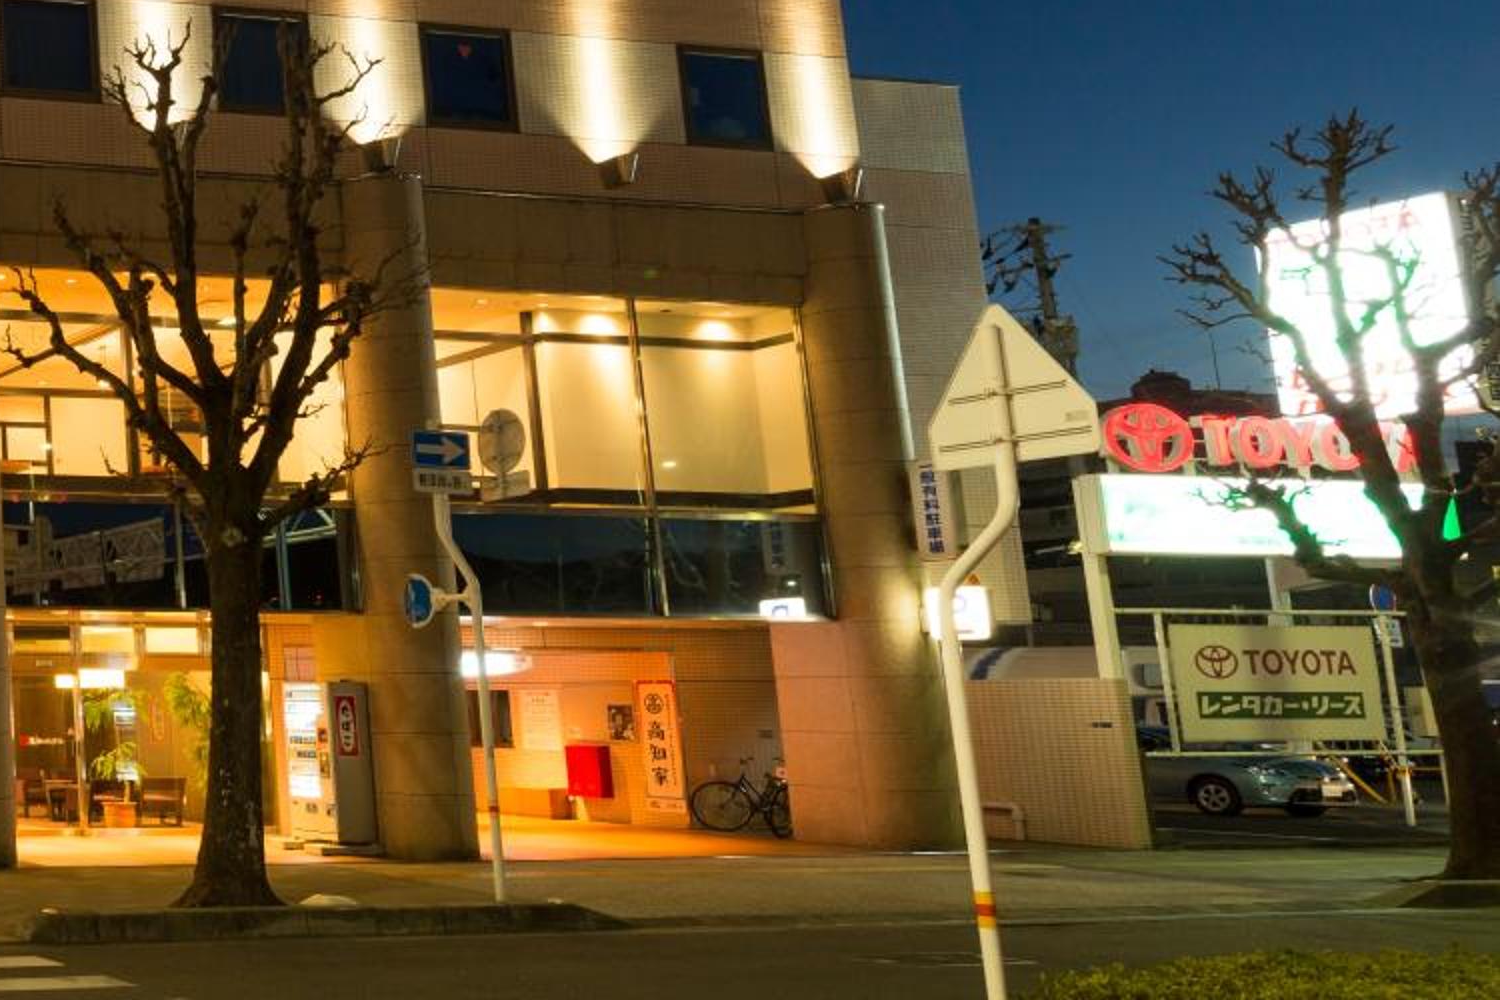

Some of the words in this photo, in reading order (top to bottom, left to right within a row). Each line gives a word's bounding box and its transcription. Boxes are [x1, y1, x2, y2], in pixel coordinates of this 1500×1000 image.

[1242, 649, 1357, 677] TOYOTA
[1201, 695, 1363, 716] レンタカー・リース
